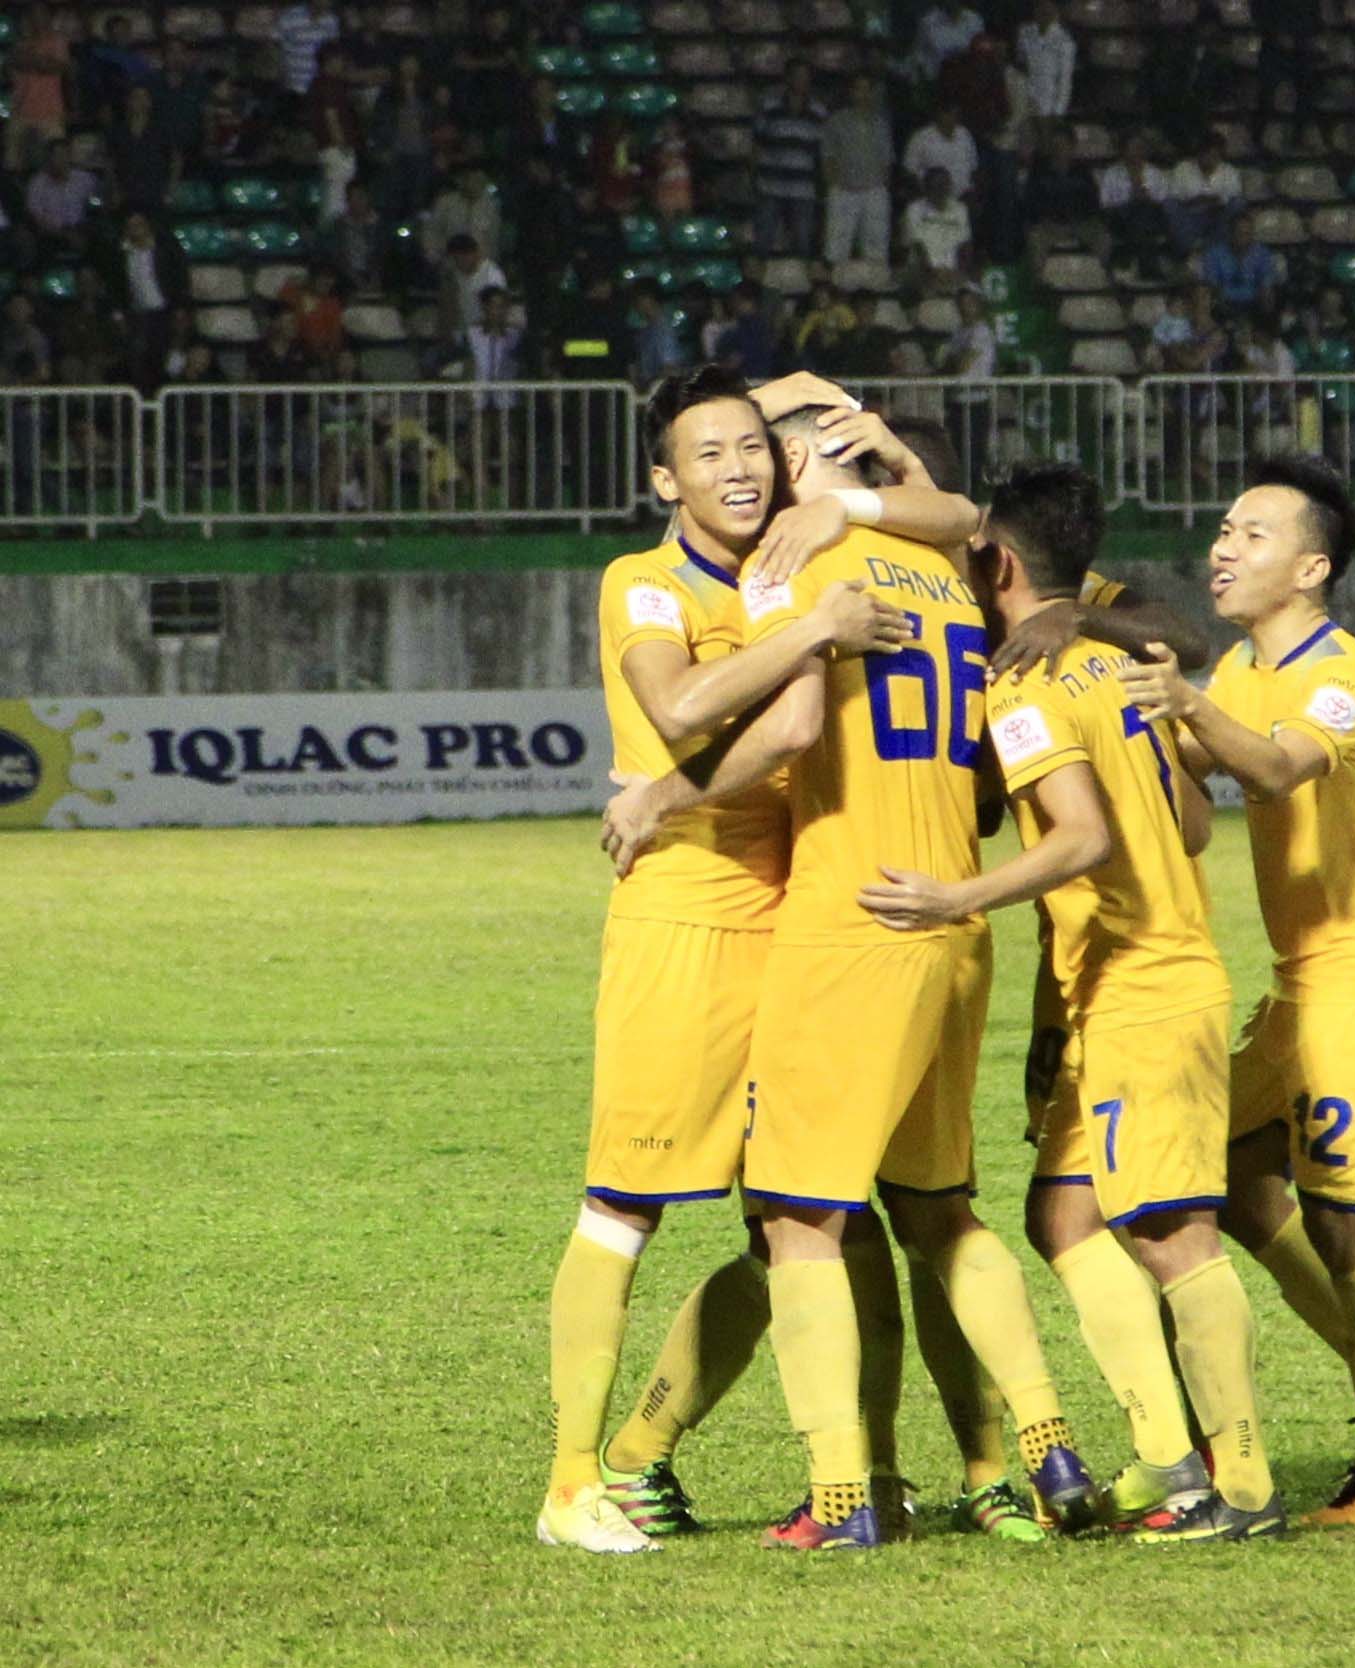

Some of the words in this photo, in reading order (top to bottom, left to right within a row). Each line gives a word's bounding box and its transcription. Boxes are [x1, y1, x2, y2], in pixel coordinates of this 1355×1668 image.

[995, 312, 1020, 344] E
[147, 724, 398, 785] IQLAC
[419, 721, 587, 770] PRO
[628, 1135, 673, 1151] mitre
[1092, 1097, 1122, 1173] 7
[641, 1376, 672, 1422] mitre
[1235, 1419, 1252, 1459] mitre
